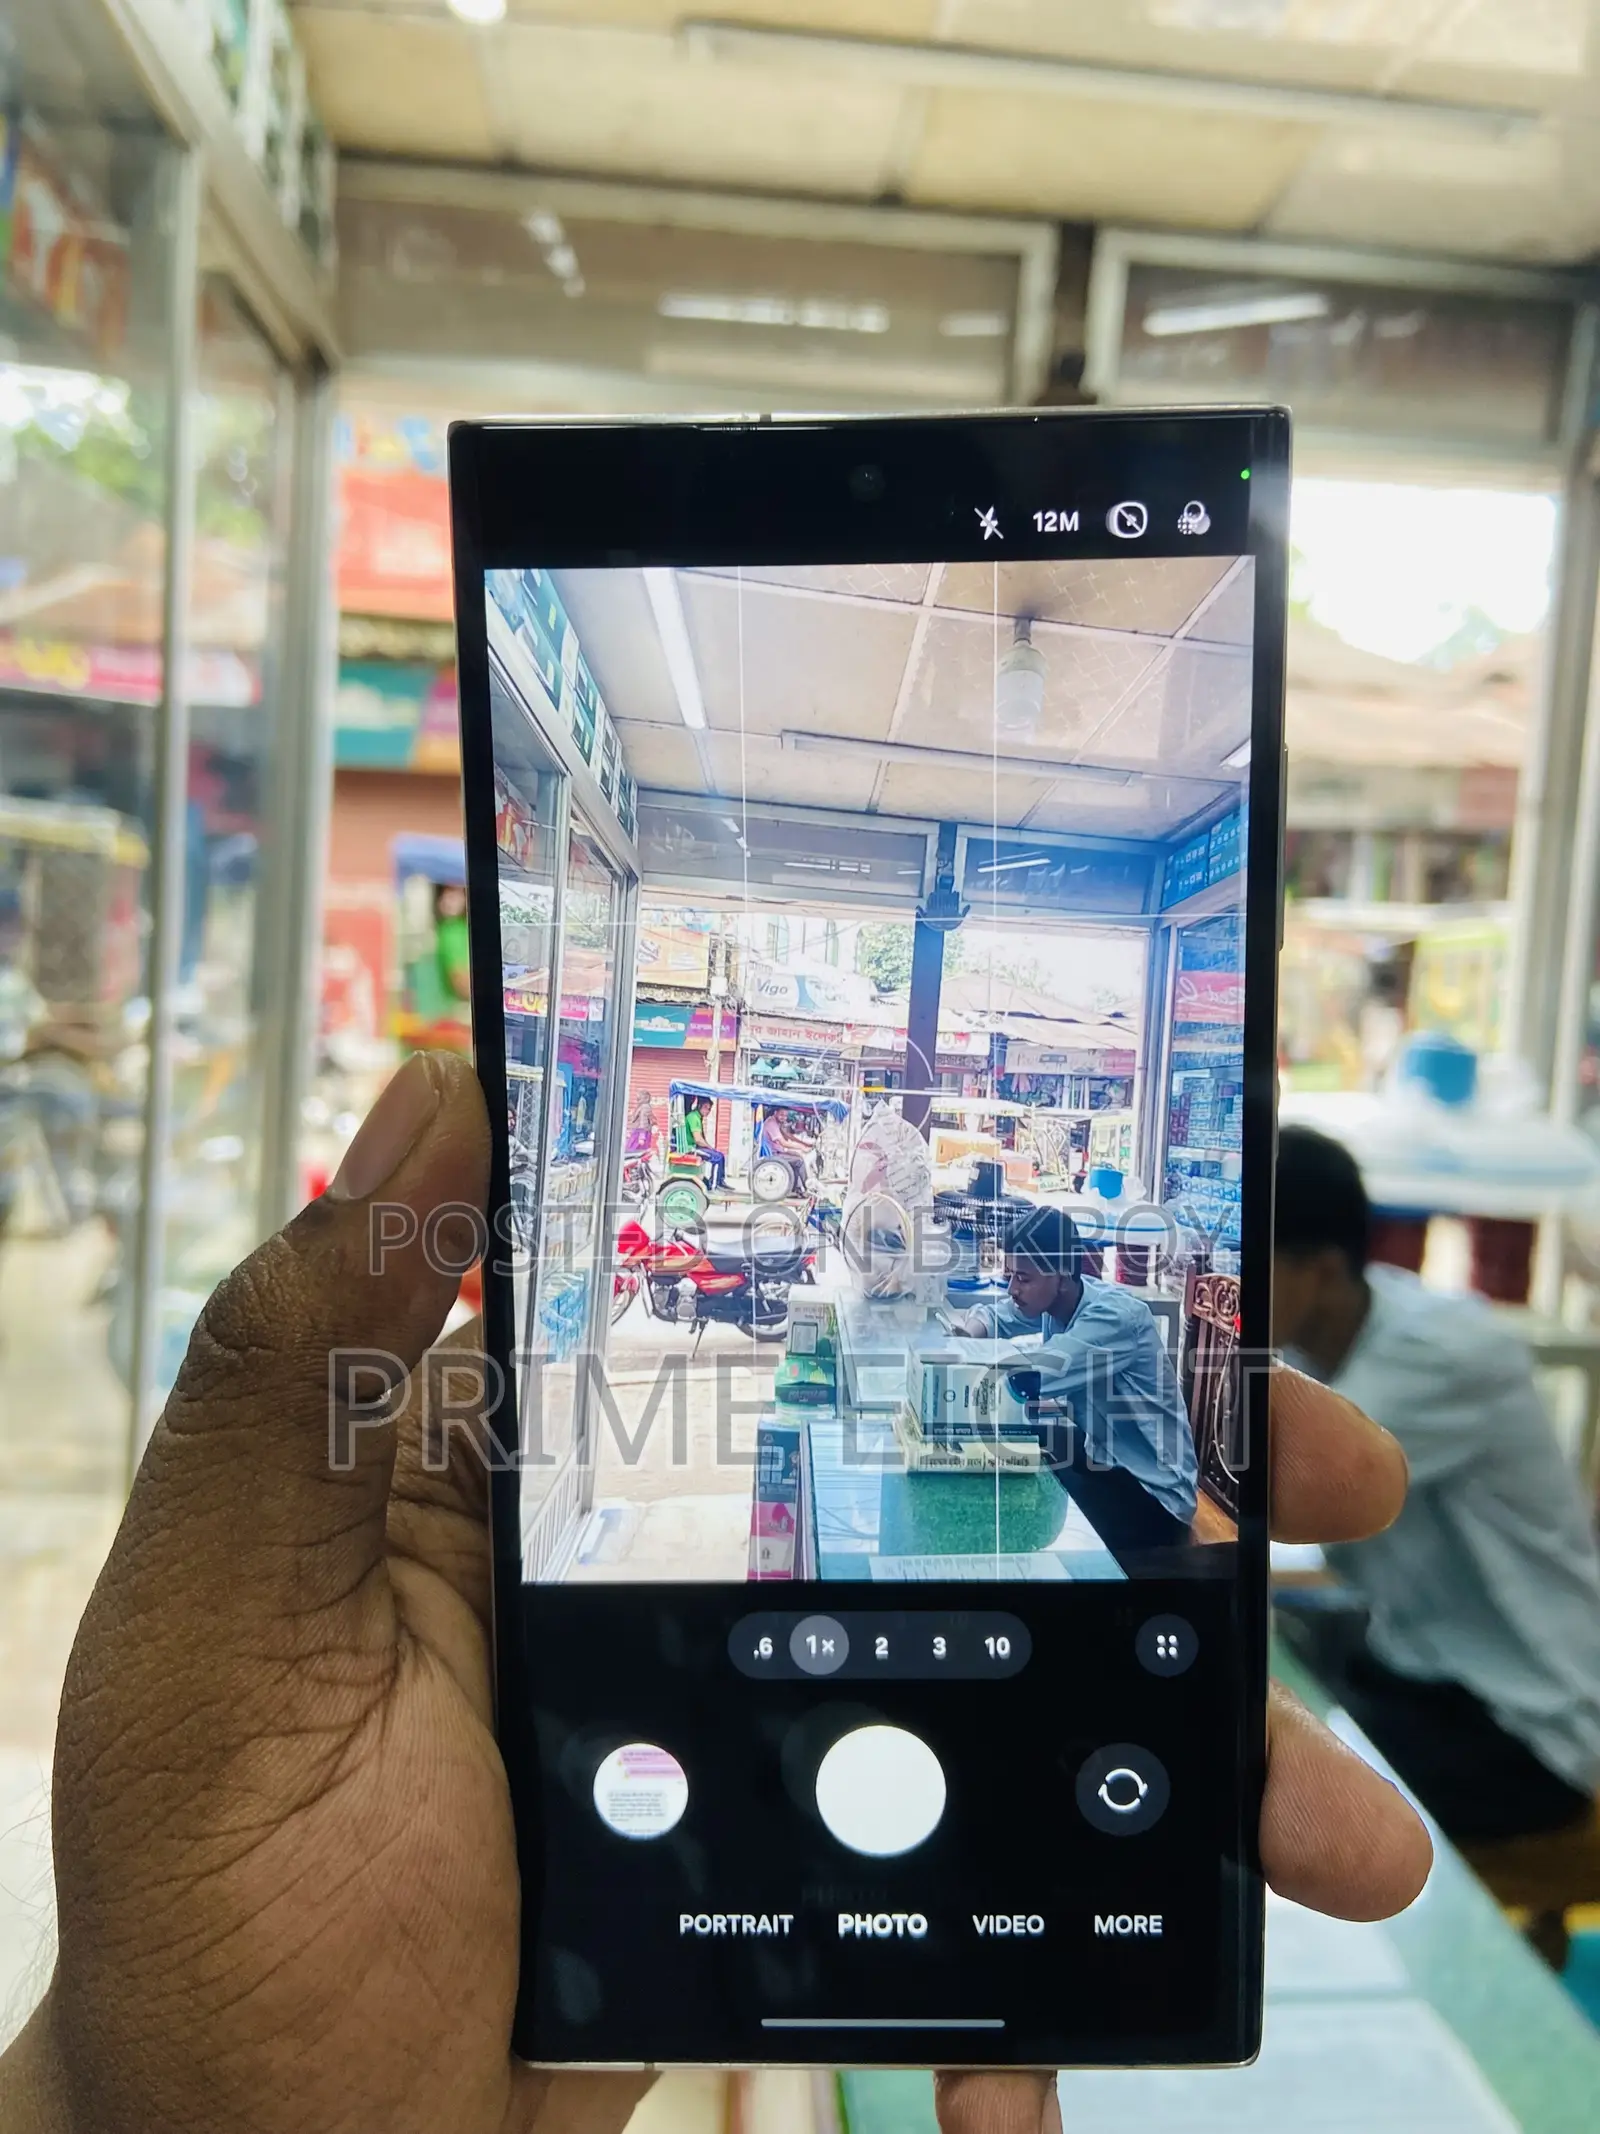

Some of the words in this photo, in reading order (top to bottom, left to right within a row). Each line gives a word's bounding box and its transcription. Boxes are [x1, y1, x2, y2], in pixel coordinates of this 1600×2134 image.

[1032, 510, 1080, 534] 12M
[756, 977, 789, 996] Vigo
[874, 1636, 890, 1659] 2
[932, 1636, 948, 1659] 3
[984, 1636, 1012, 1659] 10
[679, 1912, 794, 1936] PORTRAIT
[837, 1912, 928, 1938] PHOTO
[972, 1913, 1046, 1935] VIDEO
[1093, 1913, 1164, 1935] MORE
